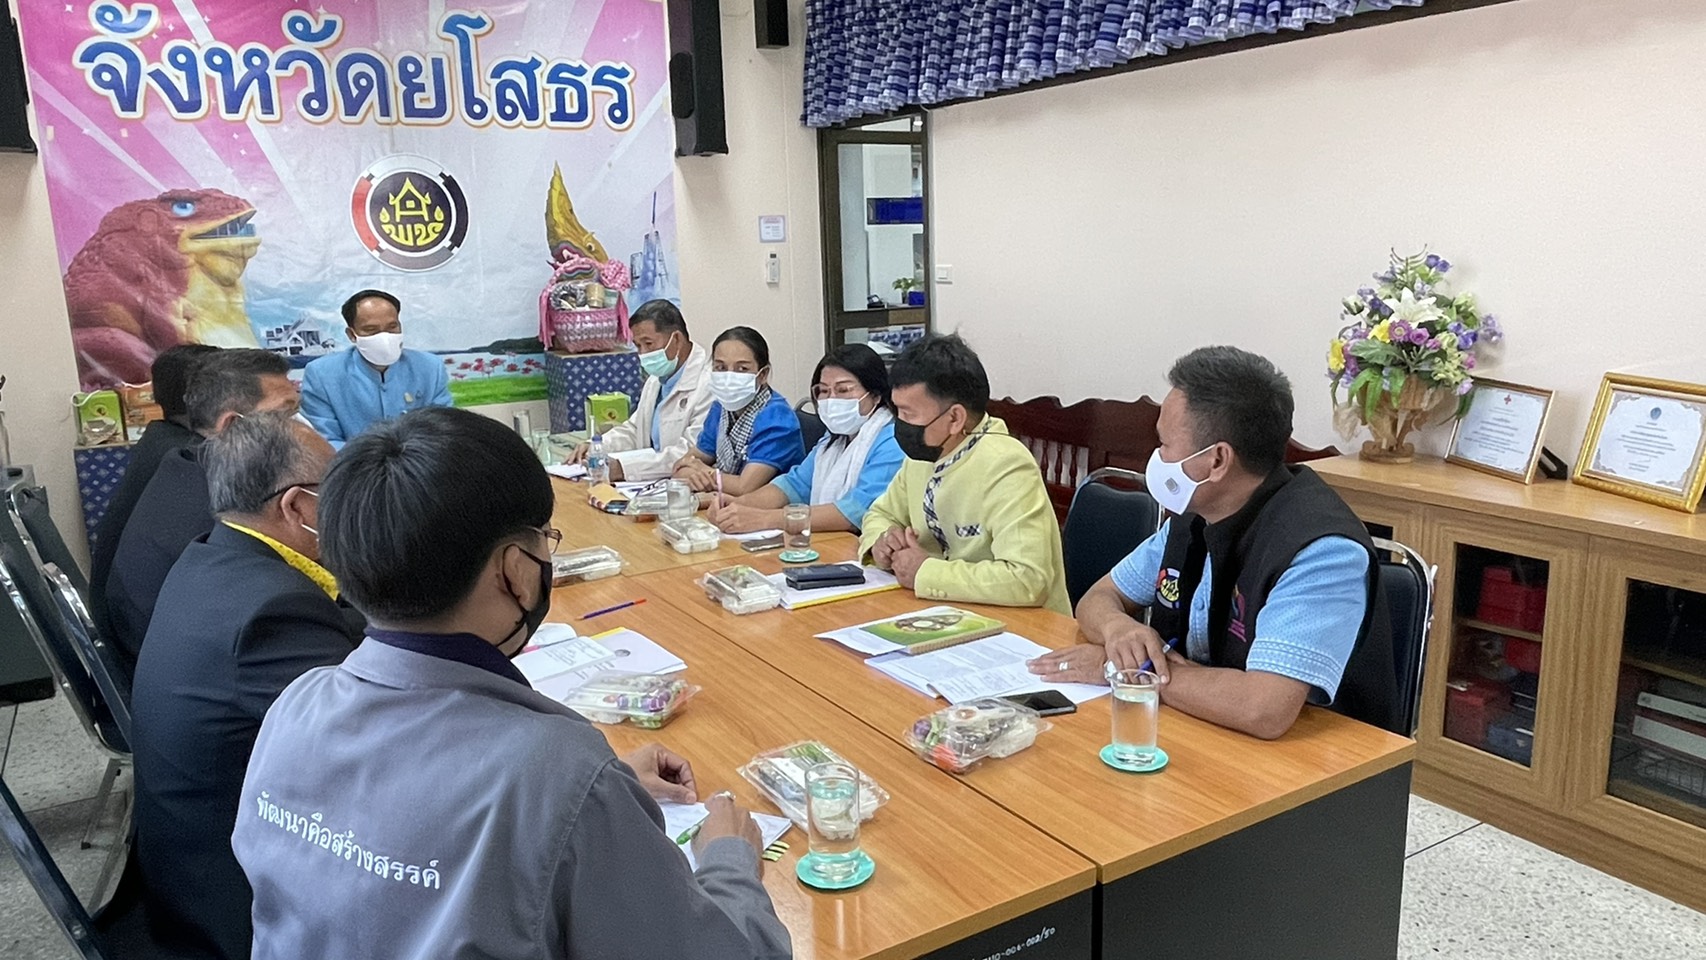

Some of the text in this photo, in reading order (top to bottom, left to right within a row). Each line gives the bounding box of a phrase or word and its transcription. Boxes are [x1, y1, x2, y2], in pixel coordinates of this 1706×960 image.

[76, 3, 632, 126] จังหวัดยโสธร
[256, 791, 441, 889] พัฒนาคือสร้างสรรค์
